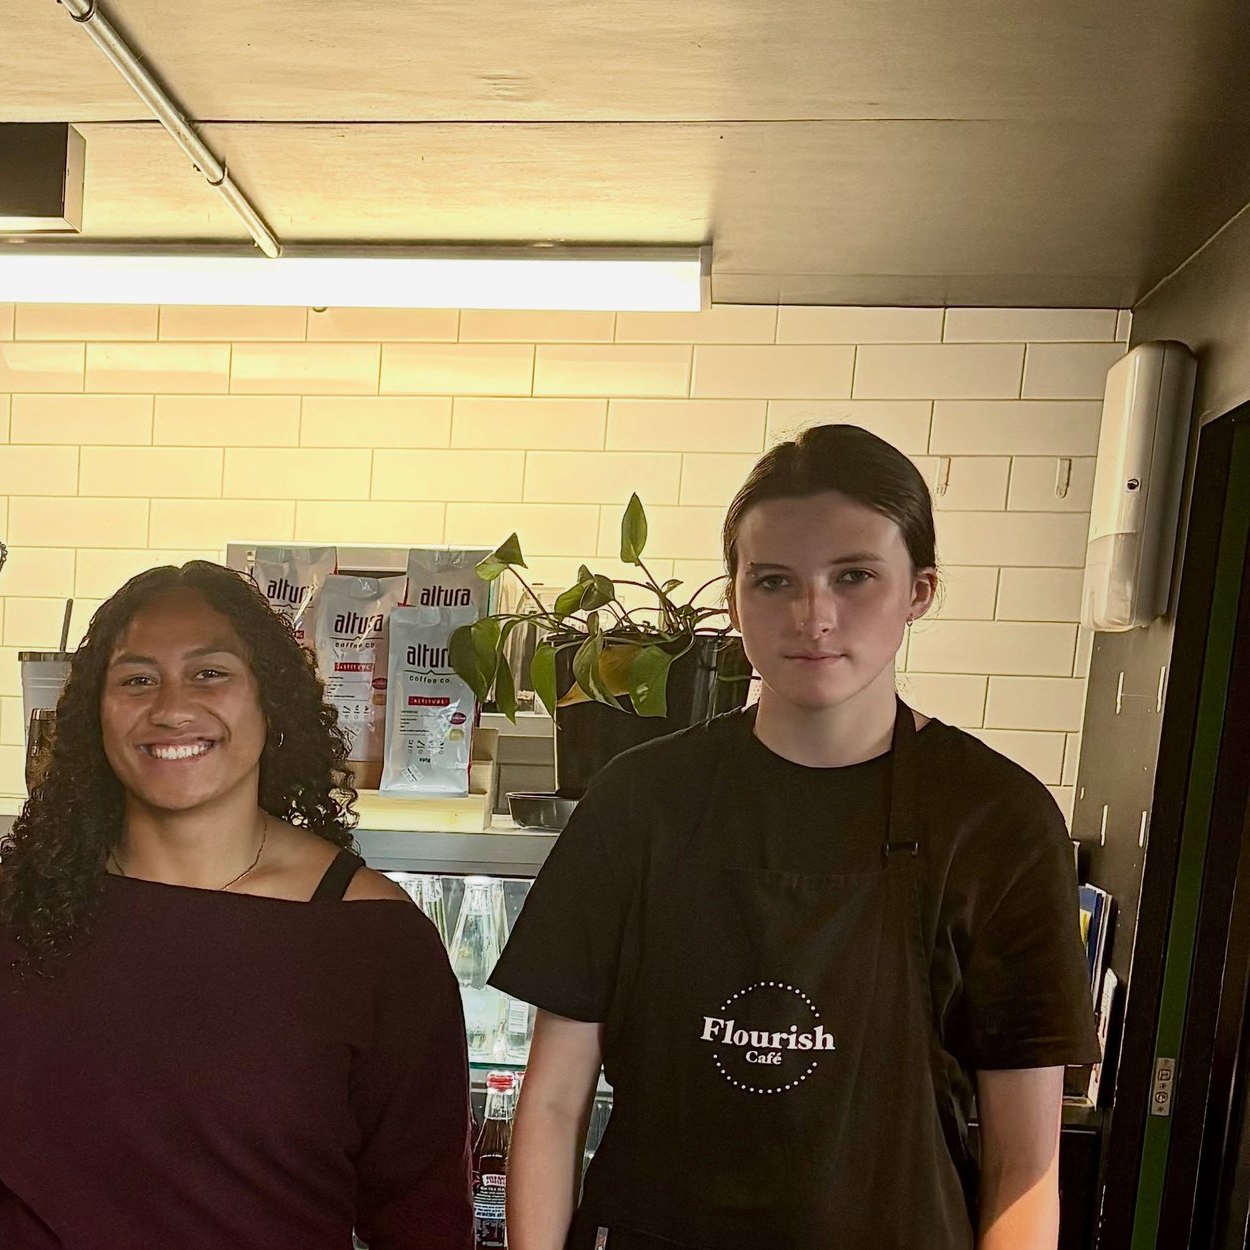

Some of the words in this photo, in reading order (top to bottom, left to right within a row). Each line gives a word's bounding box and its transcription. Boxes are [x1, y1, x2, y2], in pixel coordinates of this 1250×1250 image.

[420, 585, 471, 606] altura
[334, 611, 384, 634] altura
[700, 1016, 836, 1050] Flourish
[745, 1050, 782, 1064] Café
